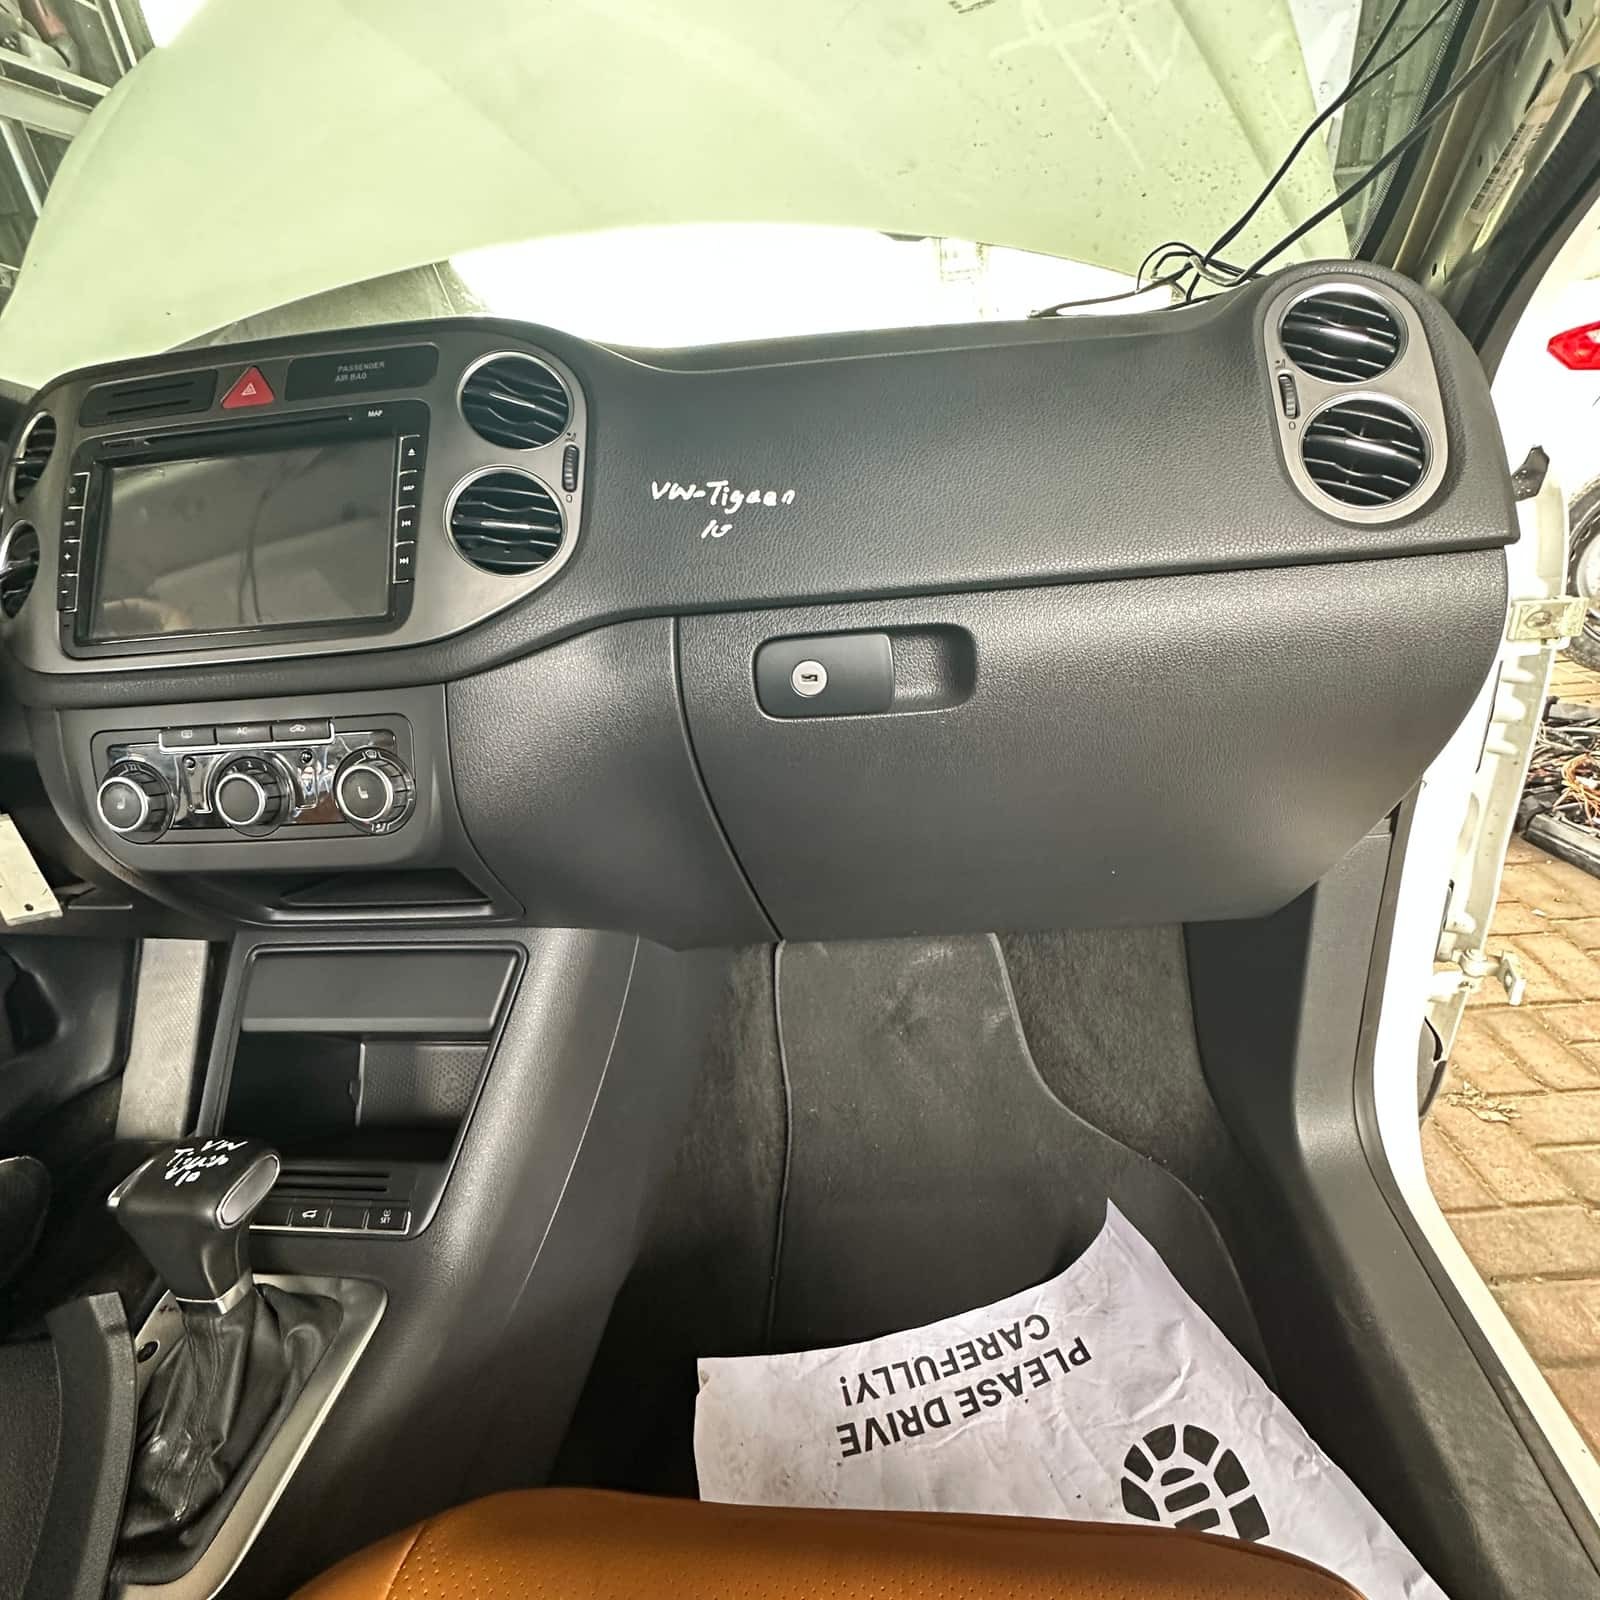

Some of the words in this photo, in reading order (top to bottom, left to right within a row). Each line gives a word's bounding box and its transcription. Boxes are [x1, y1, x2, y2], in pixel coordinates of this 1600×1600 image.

[367, 409, 383, 417] MAP
[840, 1314, 1050, 1407] CAREFULLY!
[954, 1336, 1092, 1418] PLEASE
[836, 1396, 952, 1458] DRIVE
